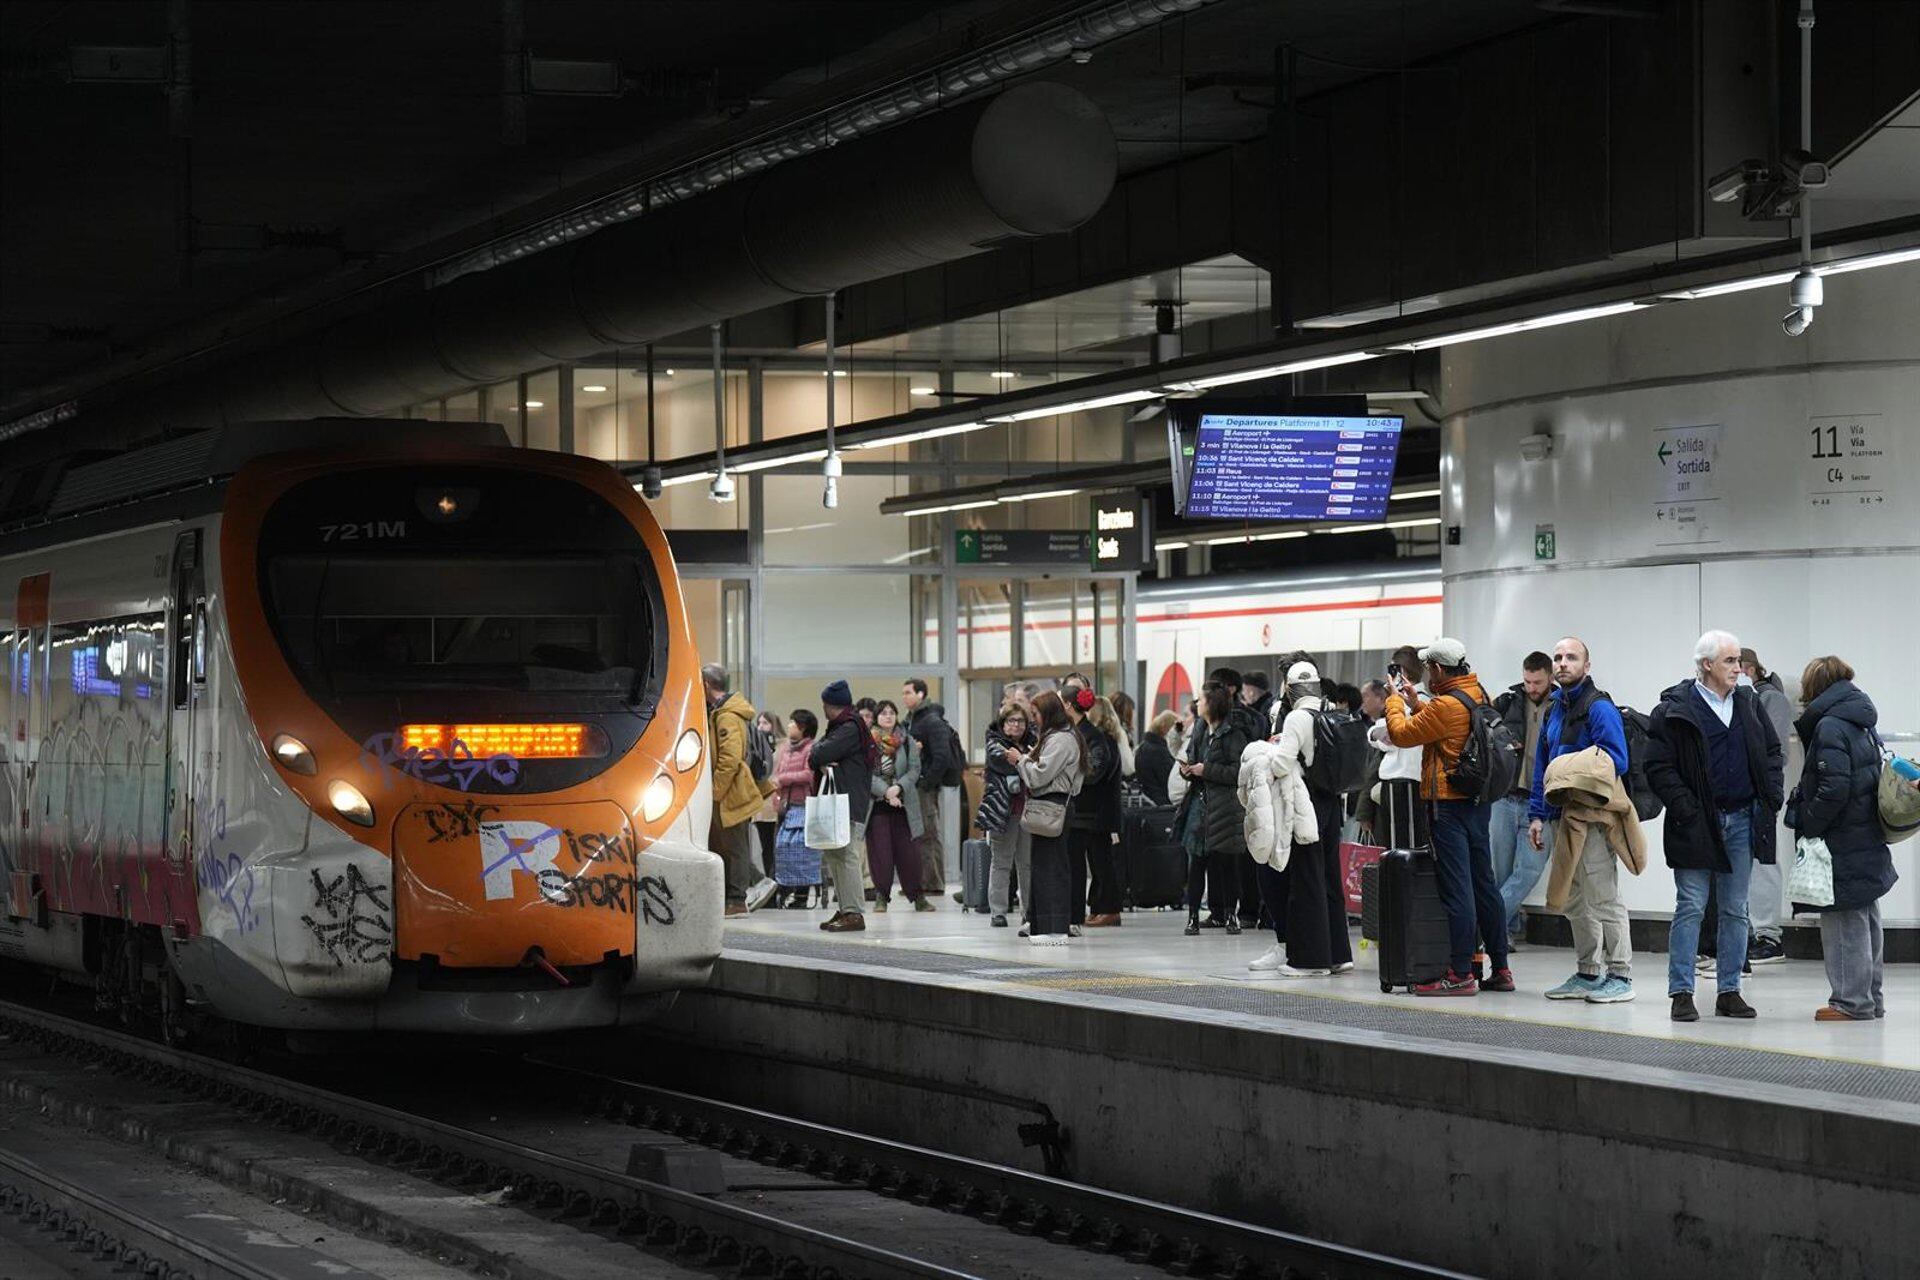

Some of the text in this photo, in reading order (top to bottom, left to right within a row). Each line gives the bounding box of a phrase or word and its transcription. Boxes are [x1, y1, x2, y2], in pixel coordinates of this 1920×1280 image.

[1226, 418, 1278, 427] Departures
[1280, 418, 1320, 428] Platforms
[1337, 420, 1345, 428] 12
[1676, 439, 1704, 453] Salida
[1811, 425, 1843, 458] 11
[1677, 459, 1711, 475] Sortida
[1827, 468, 1844, 482] C4
[319, 521, 406, 542] 721M
